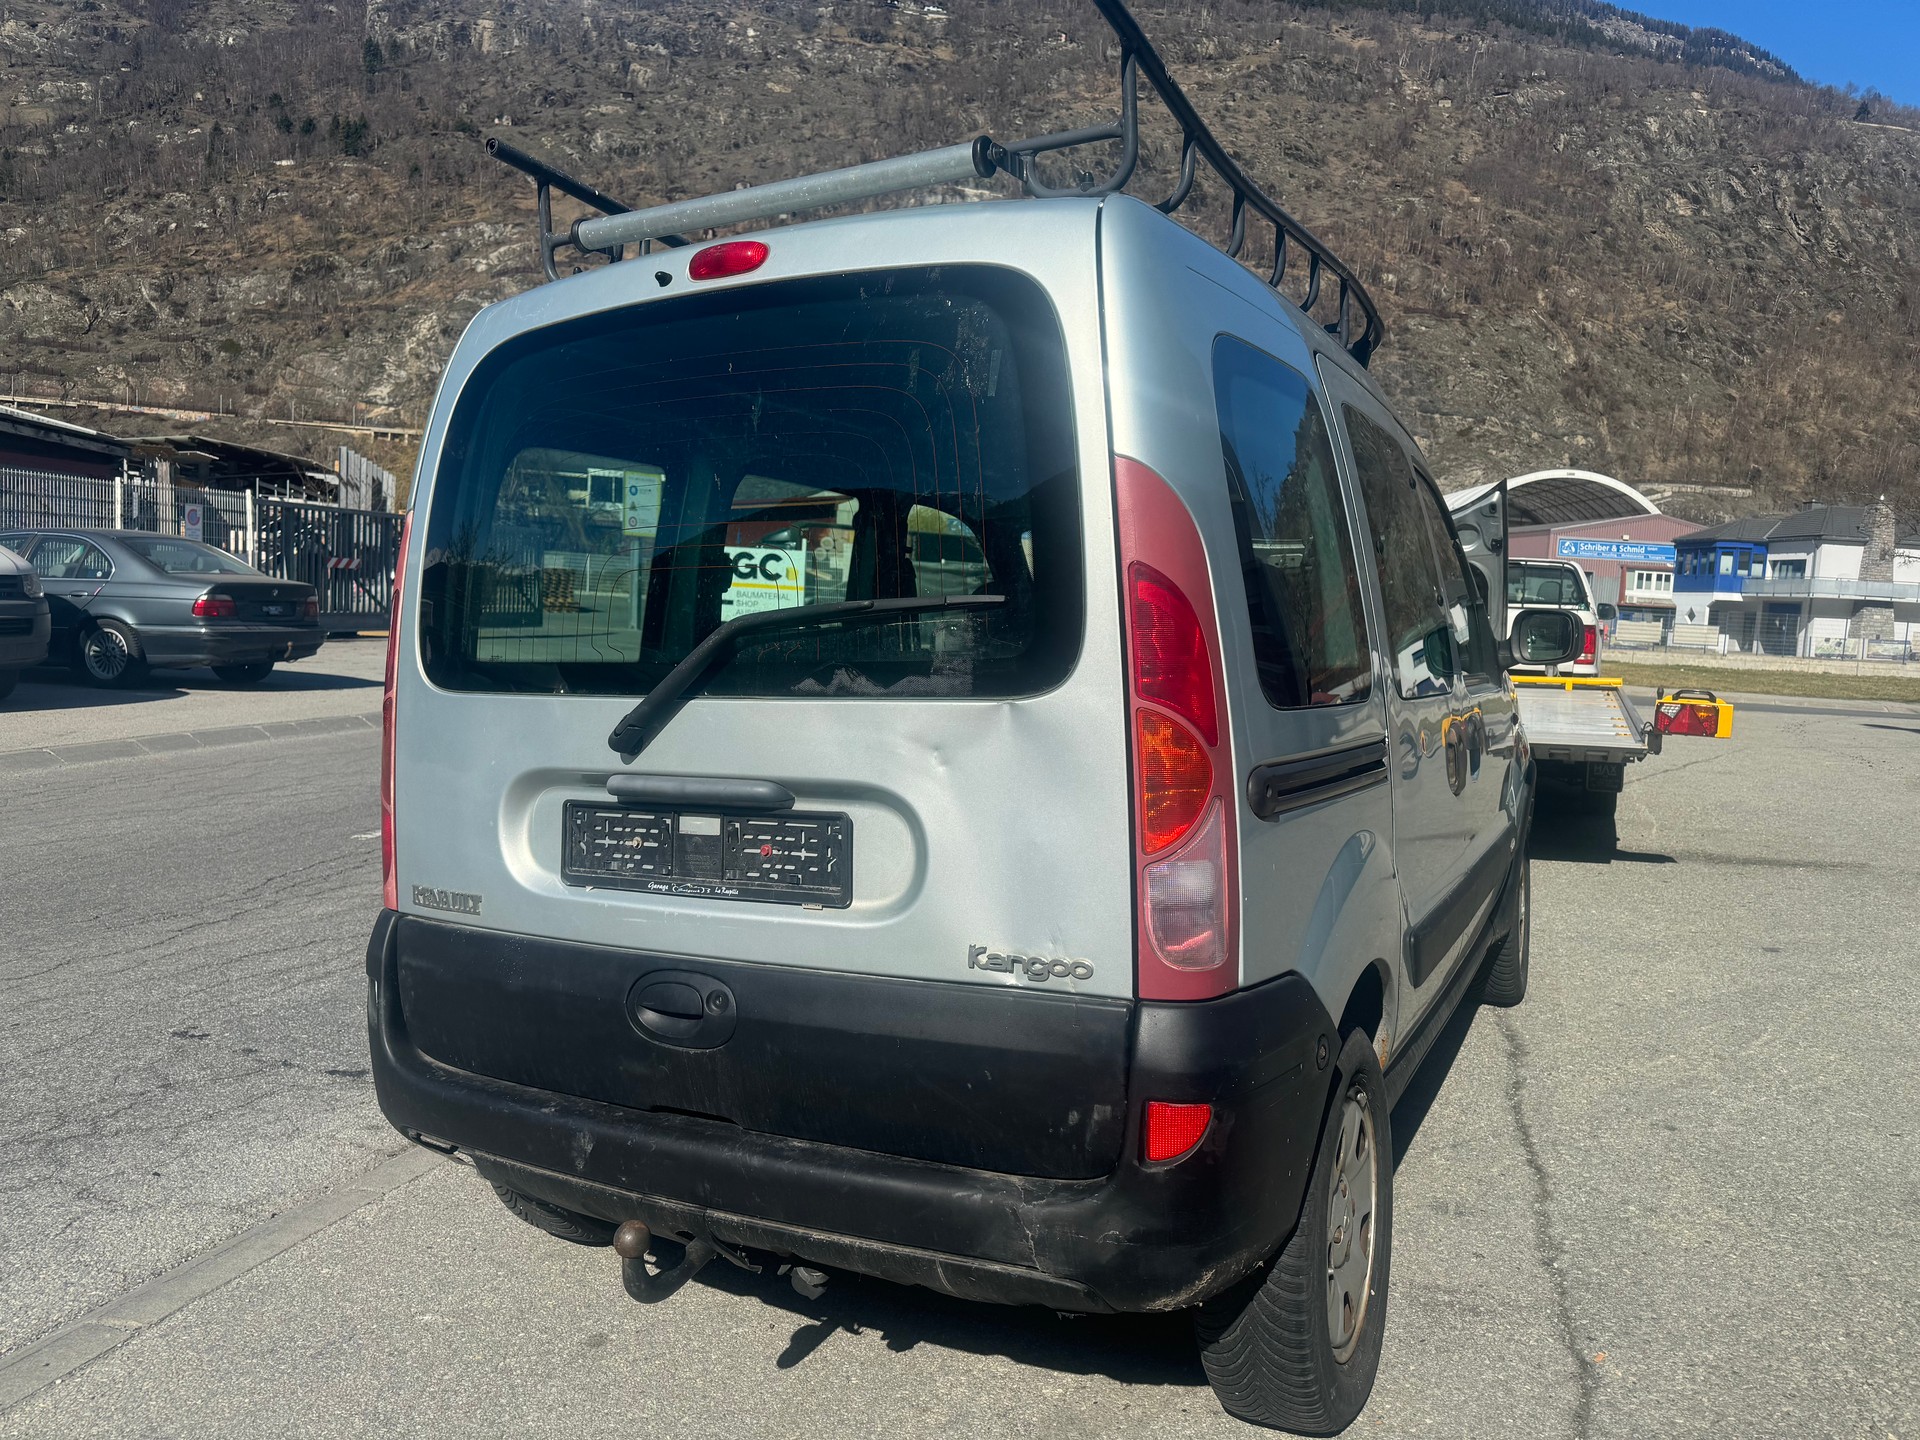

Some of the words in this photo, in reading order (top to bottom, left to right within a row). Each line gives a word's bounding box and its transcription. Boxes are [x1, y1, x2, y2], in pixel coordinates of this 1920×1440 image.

[1580, 543, 1609, 552] Schriber
[1612, 544, 1617, 552] &
[1619, 545, 1645, 554] Schmid
[726, 551, 783, 582] GC
[736, 590, 790, 601] BAUMATERIAL
[736, 599, 759, 608] SHOP
[647, 881, 669, 892] Garage
[412, 885, 482, 915] RENAULT
[968, 944, 1095, 982] Kangoo
